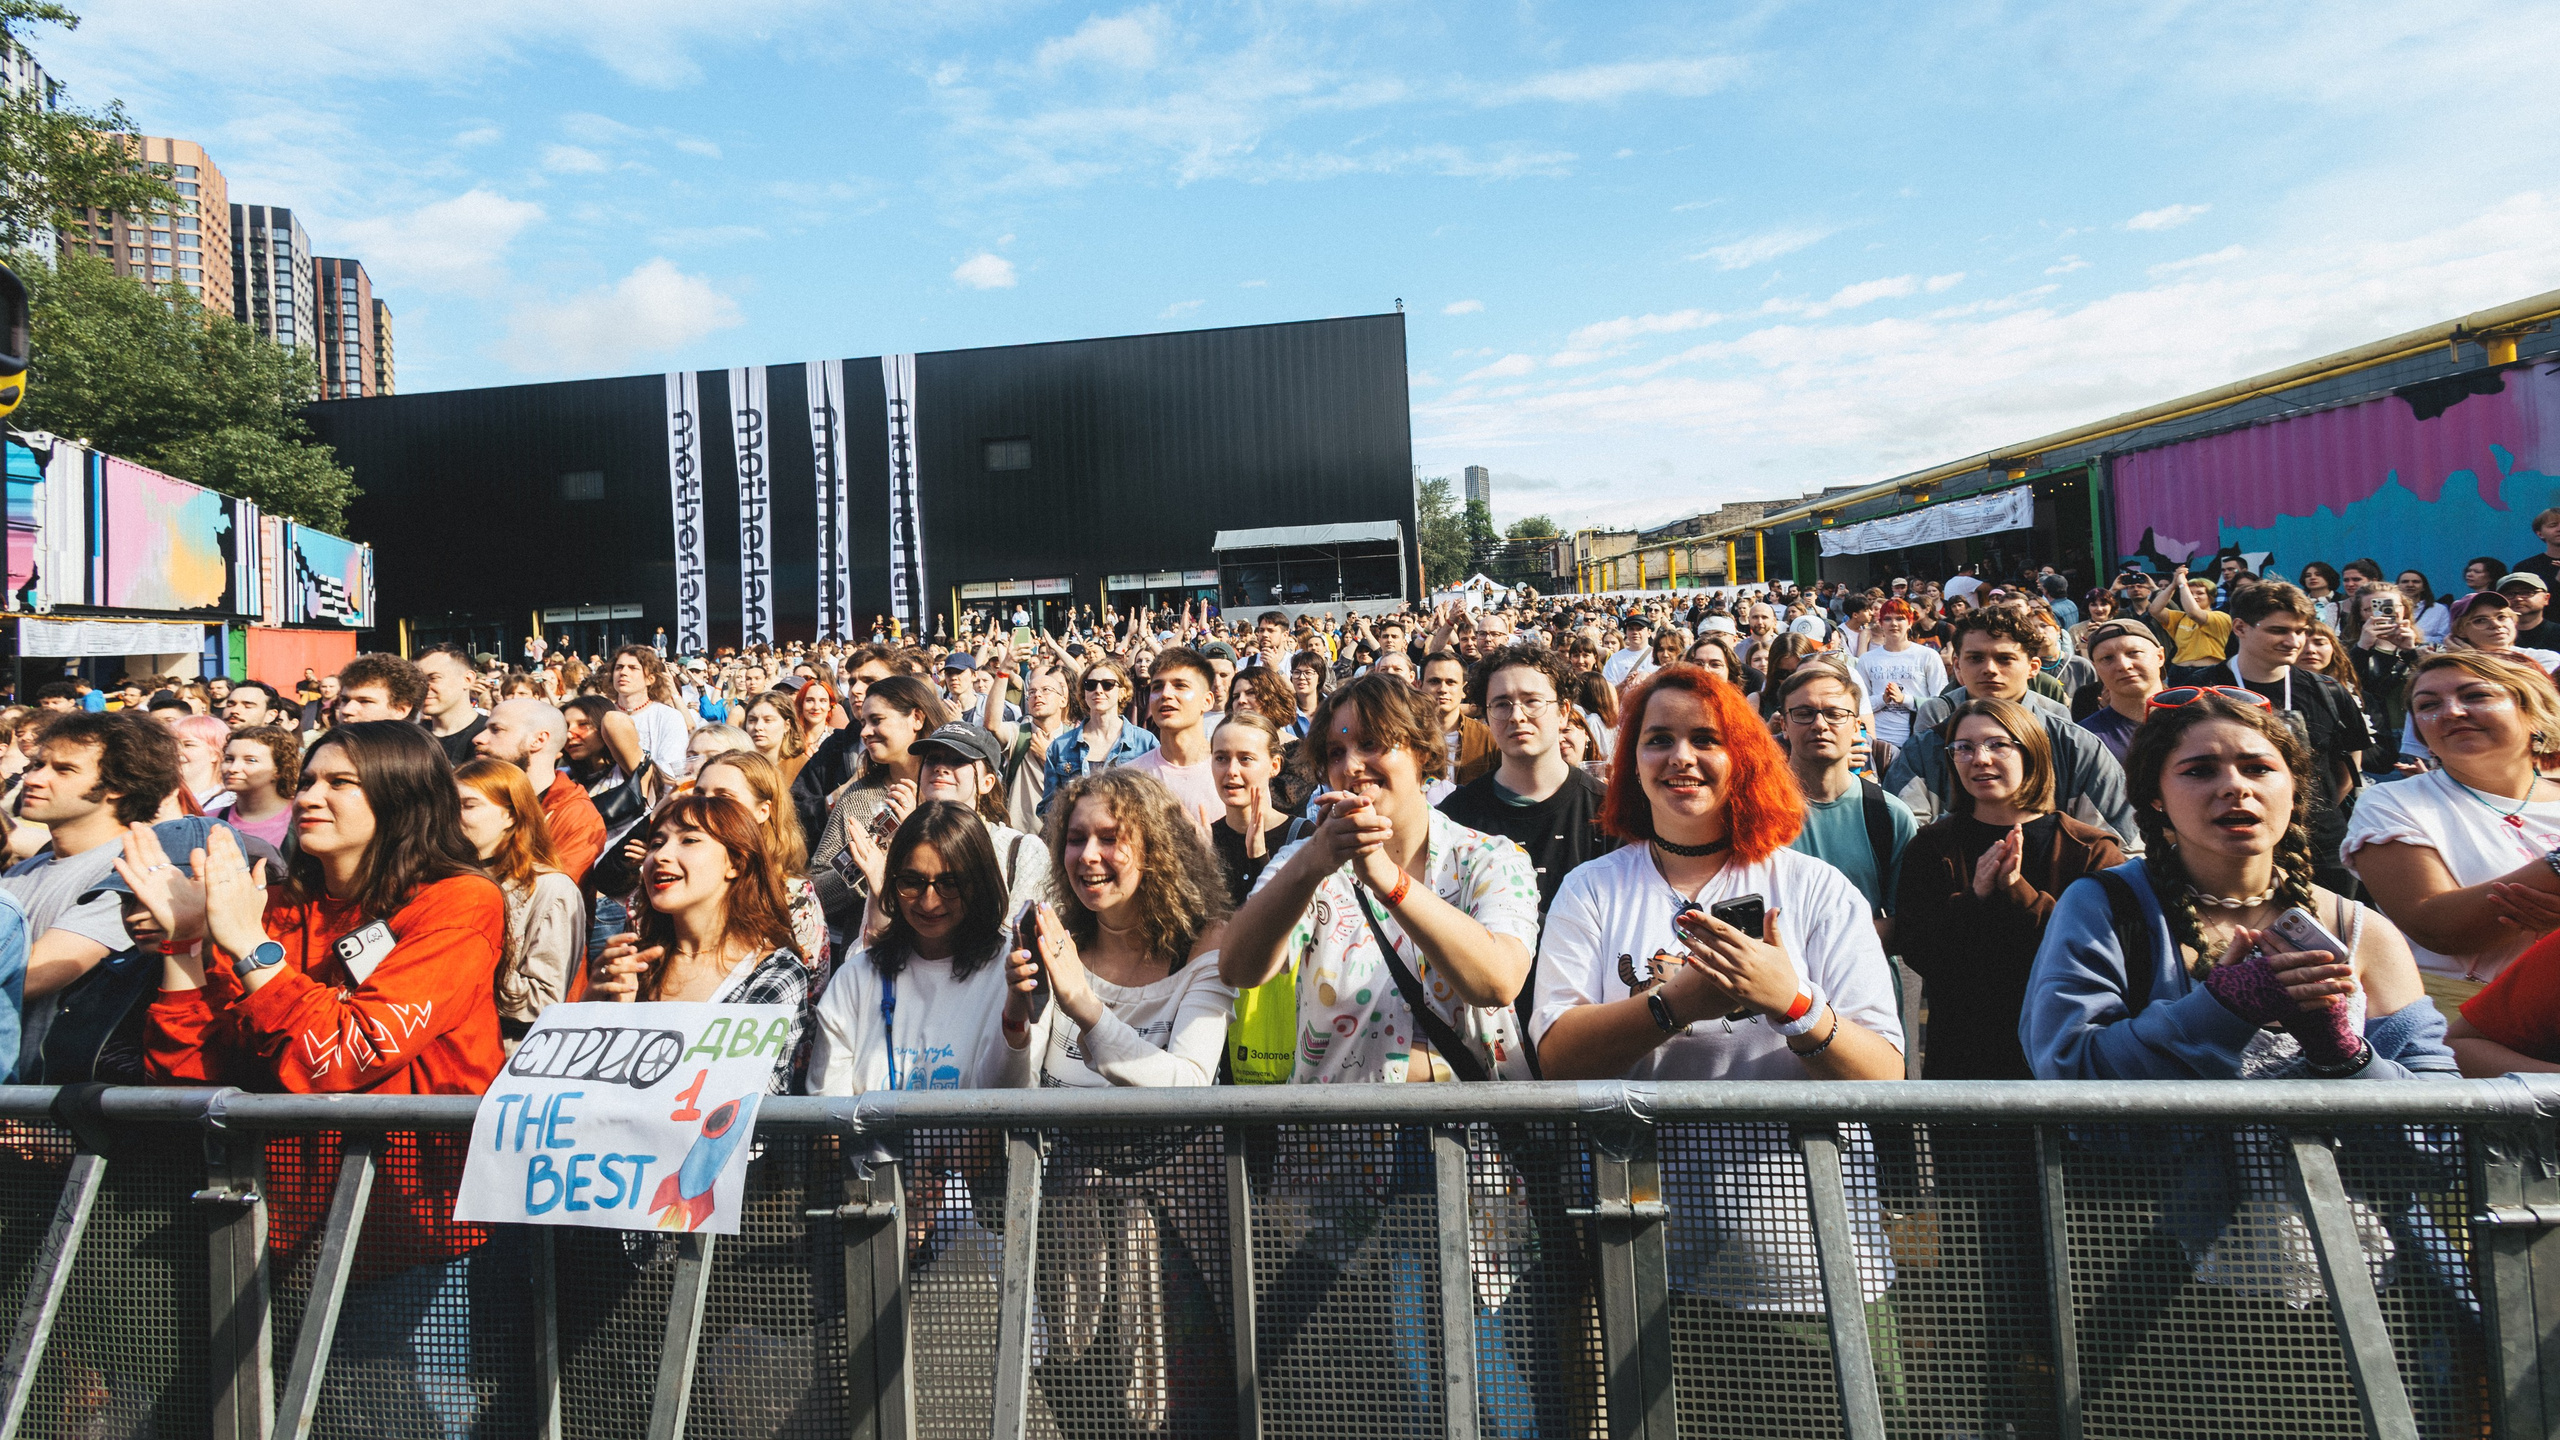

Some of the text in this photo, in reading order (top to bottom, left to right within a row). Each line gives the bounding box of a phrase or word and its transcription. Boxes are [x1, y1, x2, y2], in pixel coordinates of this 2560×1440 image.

[889, 399, 922, 640] motherlan
[683, 1017, 790, 1062] ДВА
[1250, 1049, 1290, 1060] Золотое
[495, 1091, 584, 1152] THE
[670, 1069, 708, 1121] 1
[525, 1153, 657, 1216] BEST
